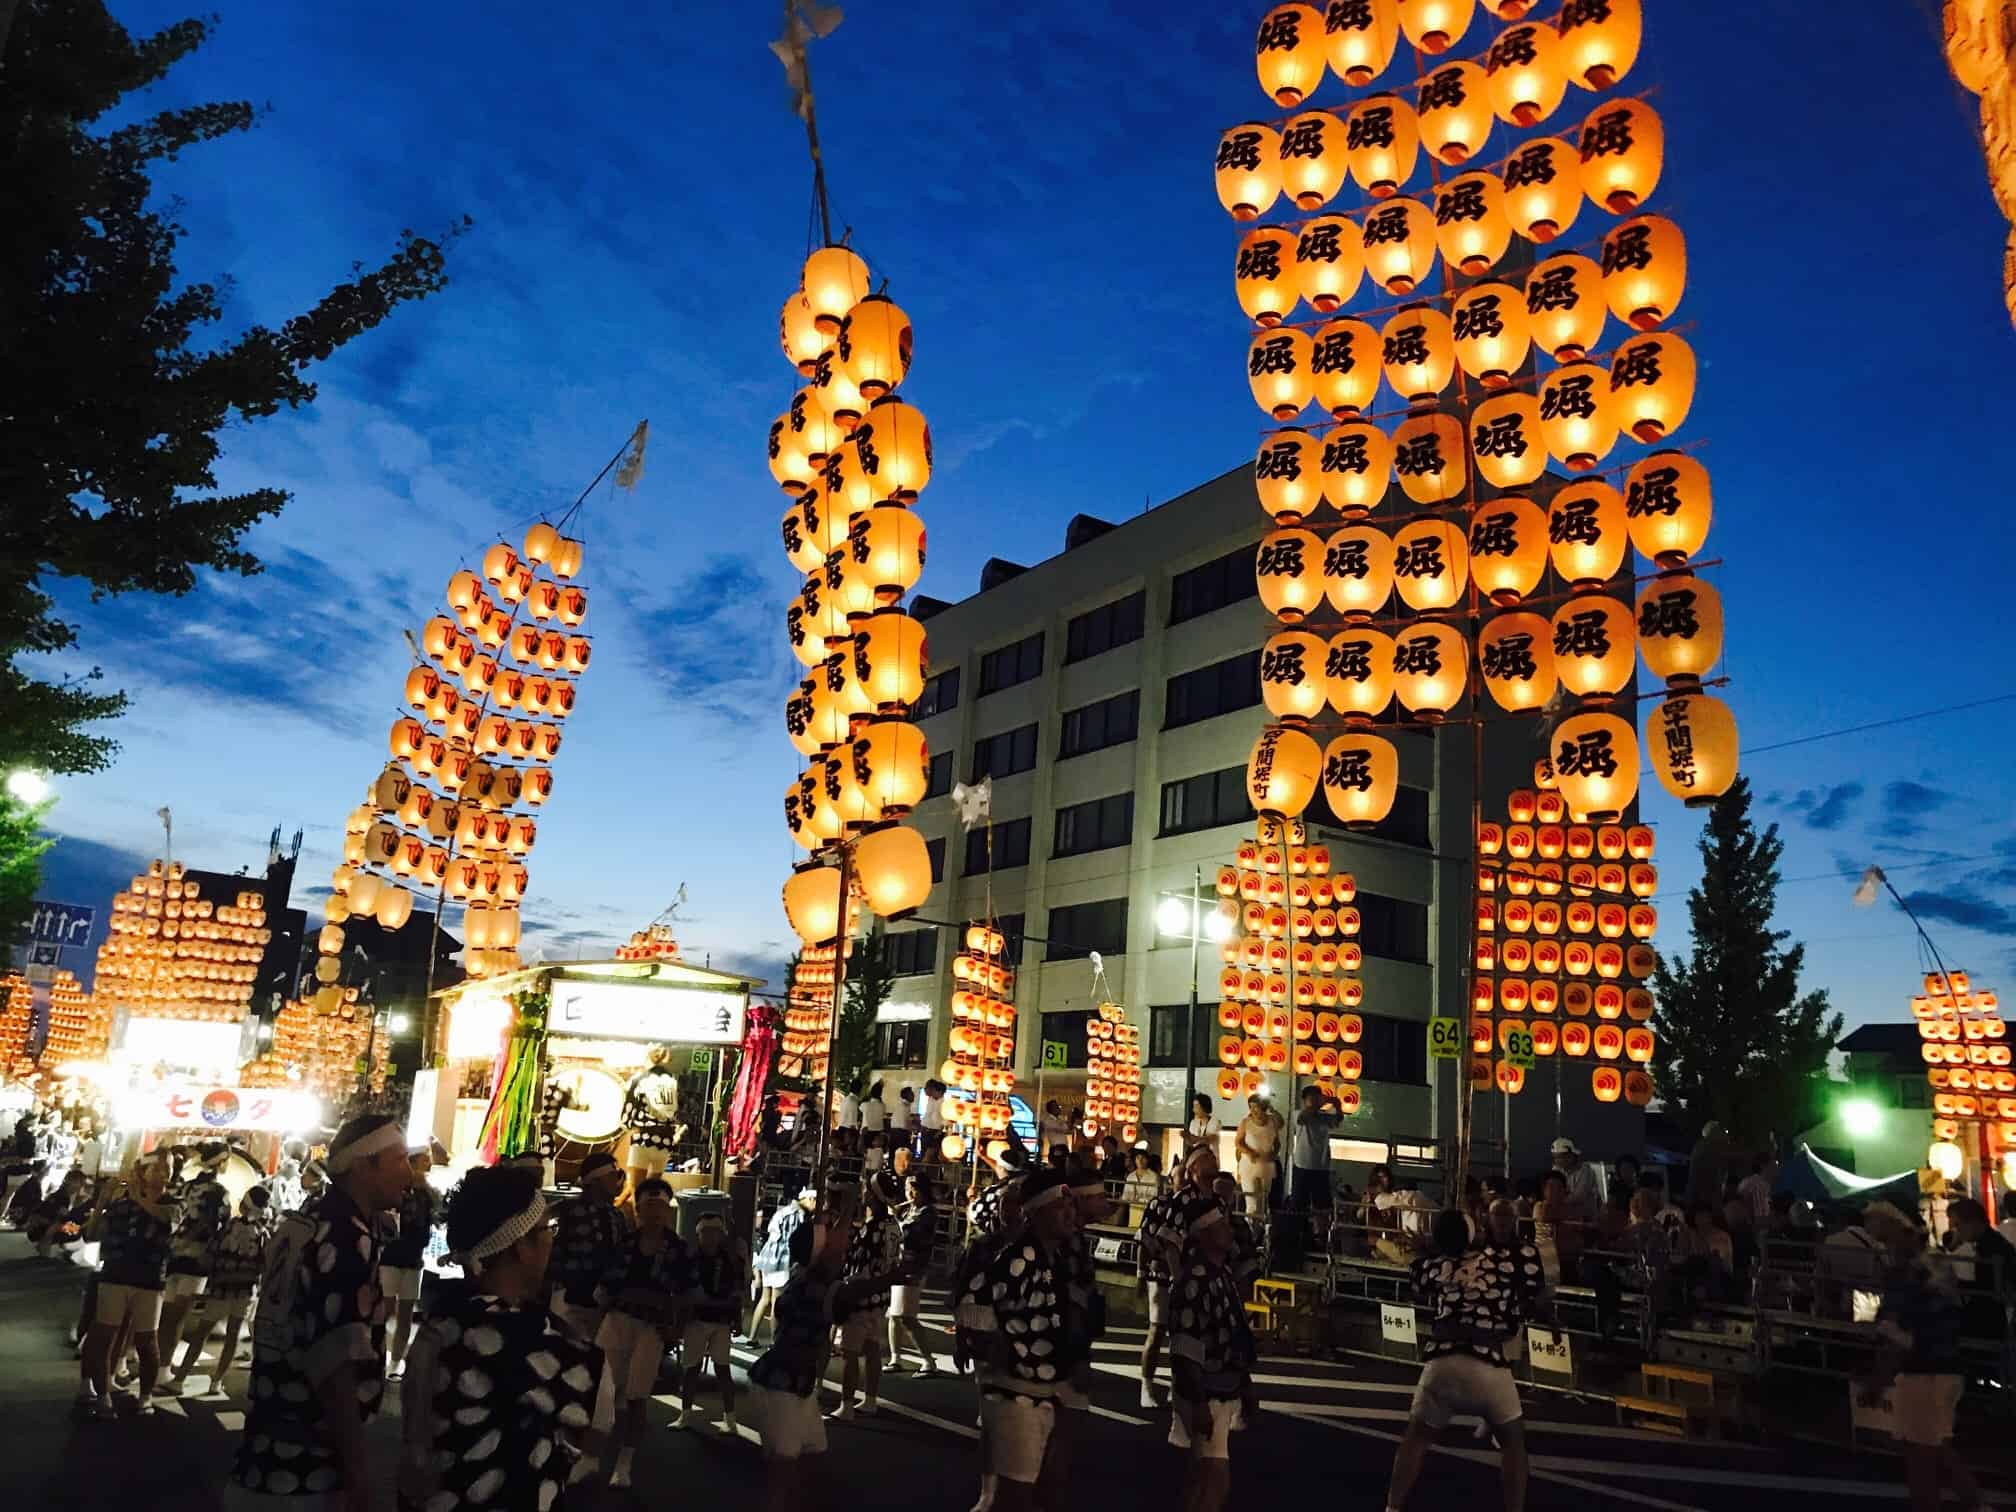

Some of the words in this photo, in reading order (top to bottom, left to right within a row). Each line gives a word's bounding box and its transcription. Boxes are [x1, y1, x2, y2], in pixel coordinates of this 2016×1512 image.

[1258, 11, 1301, 53] 堀
[1487, 27, 1536, 75] 堀
[1418, 66, 1466, 115] 堀
[1281, 119, 1325, 159] 堀
[1349, 107, 1394, 151] 堀
[1580, 109, 1634, 162] 堀
[1217, 133, 1262, 171] 堀
[1504, 144, 1555, 192] 堀
[1436, 181, 1487, 225] 堀
[1297, 225, 1343, 262] 堀
[1364, 207, 1408, 245] 堀
[1238, 241, 1282, 280] 堀
[1602, 225, 1652, 278] 堀
[1527, 266, 1579, 311] 堀
[1453, 295, 1503, 340] 堀
[1249, 336, 1296, 376] 堀
[1311, 331, 1355, 373] 堀
[1382, 326, 1430, 365] 堀
[1610, 343, 1662, 391] 堀
[1539, 375, 1596, 419] 堀
[1322, 435, 1369, 473] 堀
[1395, 433, 1445, 477] 堀
[1475, 413, 1527, 458] 堀
[1257, 442, 1301, 482] 堀
[1625, 467, 1683, 519] 堀
[1470, 512, 1519, 557] 堀
[1549, 498, 1601, 545] 堀
[1258, 536, 1305, 577] 堀
[1323, 539, 1369, 579] 堀
[1396, 536, 1445, 578] 堀
[1553, 610, 1609, 658] 堀
[1637, 589, 1699, 639] 堀
[1261, 644, 1306, 686] 堀
[1326, 641, 1374, 681] 堀
[1393, 637, 1442, 678] 堀
[1482, 634, 1536, 681] 堀
[1326, 747, 1374, 792] 堀
[1557, 729, 1618, 778] 堀
[1046, 1044, 1064, 1062] 61
[1432, 1022, 1459, 1045] 64
[1508, 1032, 1533, 1056] 63
[693, 1051, 710, 1065] 60
